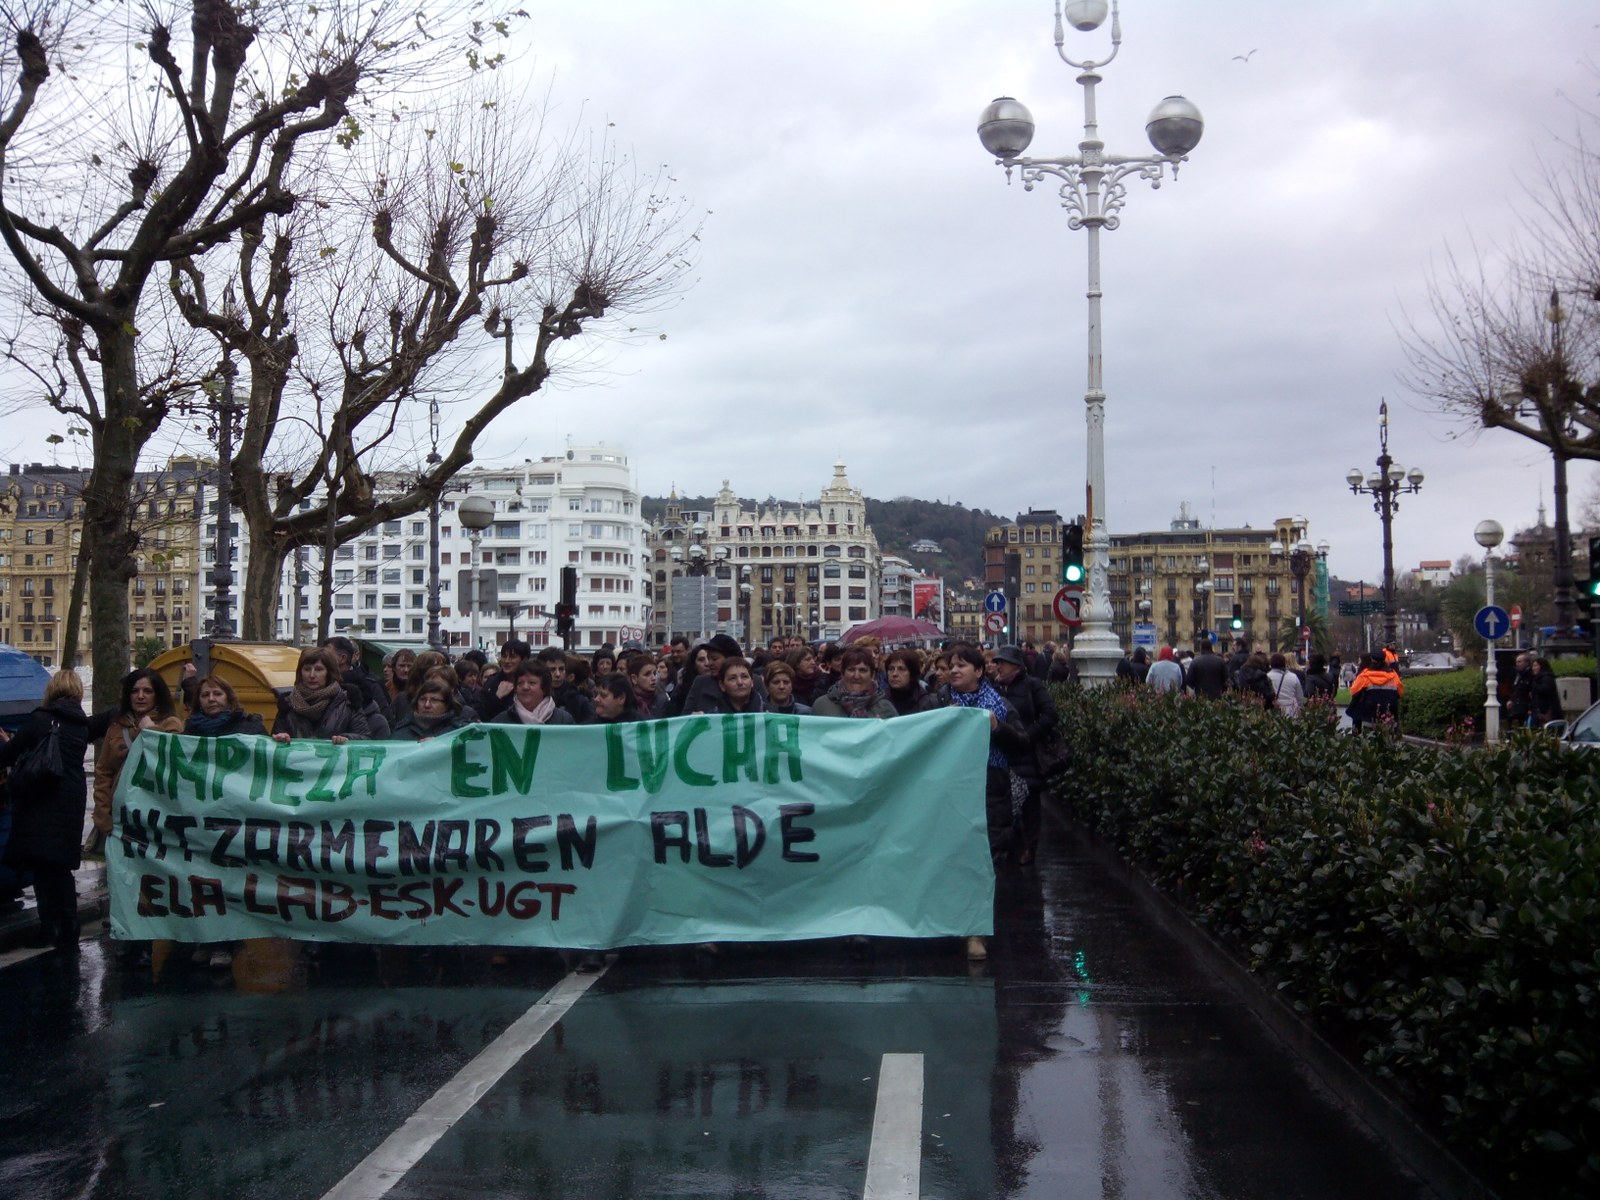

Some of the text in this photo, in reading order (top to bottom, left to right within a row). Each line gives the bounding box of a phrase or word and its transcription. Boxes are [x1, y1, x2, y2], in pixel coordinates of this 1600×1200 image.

[131, 713, 804, 807] LIMPIEZA EN LUCHA
[119, 803, 820, 879] HITZARMENAREN ALDE
